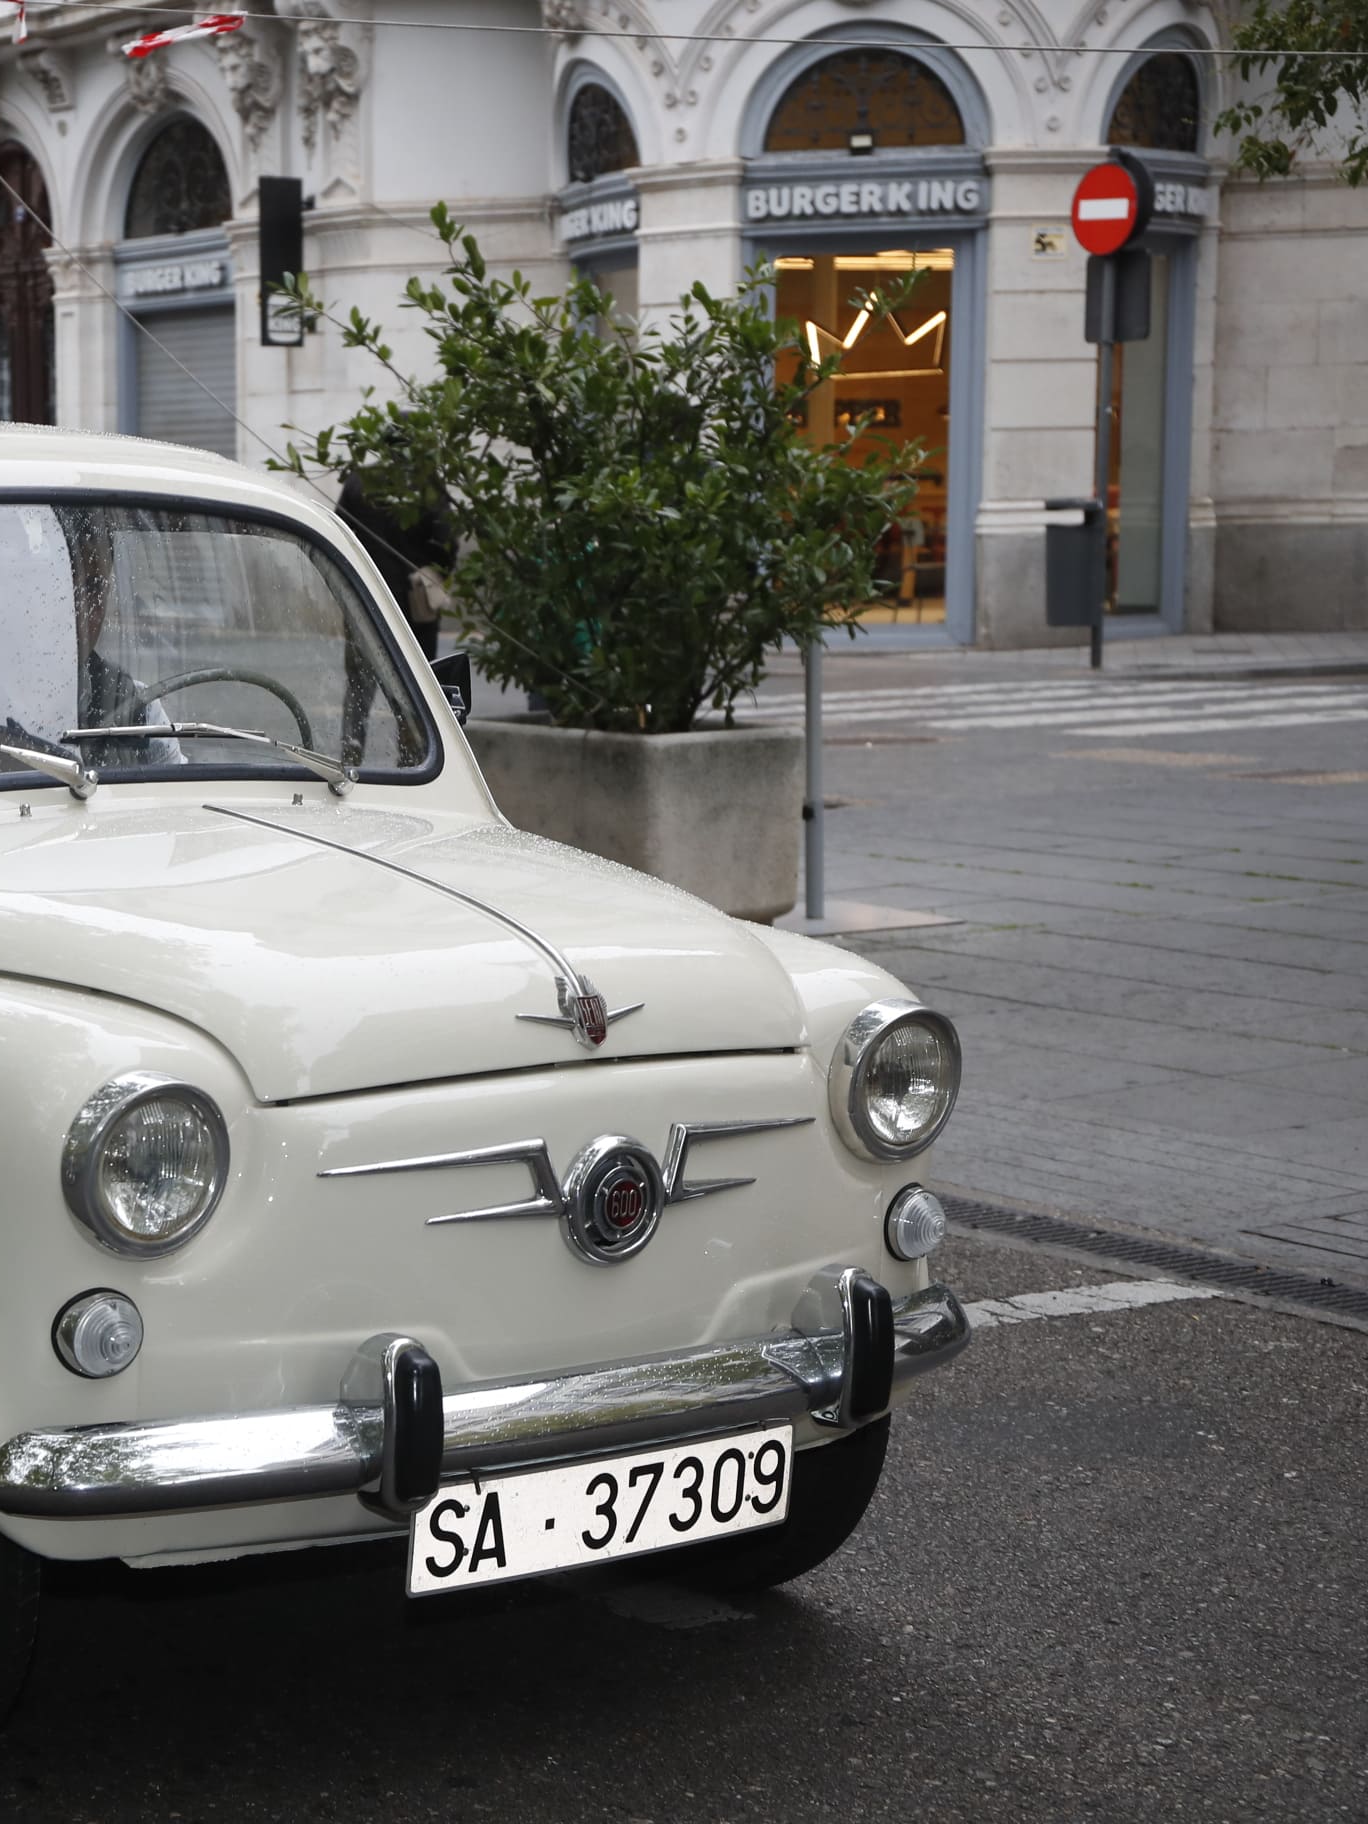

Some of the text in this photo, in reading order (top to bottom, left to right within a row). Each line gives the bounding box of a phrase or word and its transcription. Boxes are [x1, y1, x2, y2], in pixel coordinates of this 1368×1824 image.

[612, 1190, 638, 1218] 600
[425, 1491, 507, 1578] SA
[581, 1439, 787, 1551] 37309
